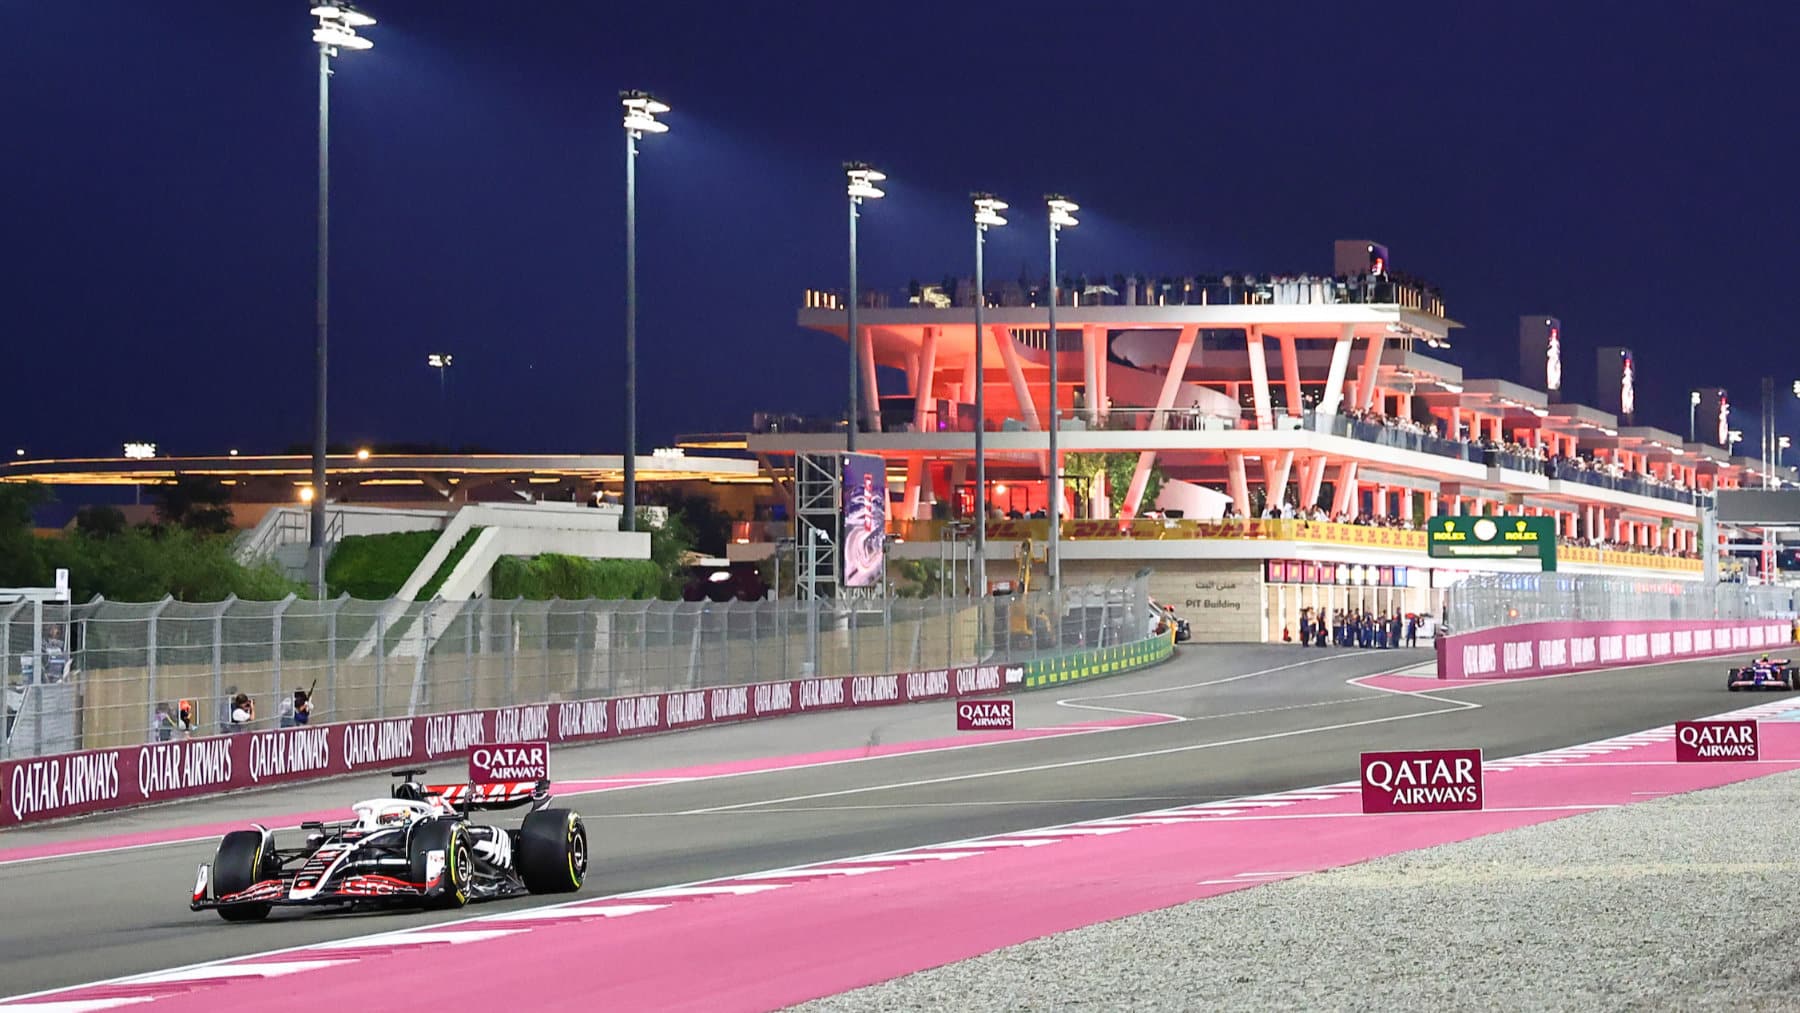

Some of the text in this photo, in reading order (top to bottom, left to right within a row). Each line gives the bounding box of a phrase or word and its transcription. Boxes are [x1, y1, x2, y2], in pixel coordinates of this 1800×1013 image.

[1433, 532, 1466, 540] ROLEX
[1505, 532, 1538, 540] ROLEX
[1185, 599, 1241, 610] PIT Building
[959, 704, 1011, 720] QATAR
[971, 717, 1012, 727] AIRWAYS
[344, 719, 414, 769] QATAR AIRWAYS
[426, 712, 485, 759] QATAR AIRWAYS
[1680, 726, 1754, 748] QATAR
[249, 727, 330, 782] QATAR AIRWAYS
[473, 748, 544, 770] QATAR
[1697, 744, 1755, 757] AIRWAYS
[139, 737, 232, 799] QATAR AIRWAYS
[490, 766, 545, 779] AIRWAYS
[1366, 758, 1475, 792] QATAR
[11, 751, 119, 821] QATAR AIRWAYS
[1392, 786, 1477, 805] AIRWAYS
